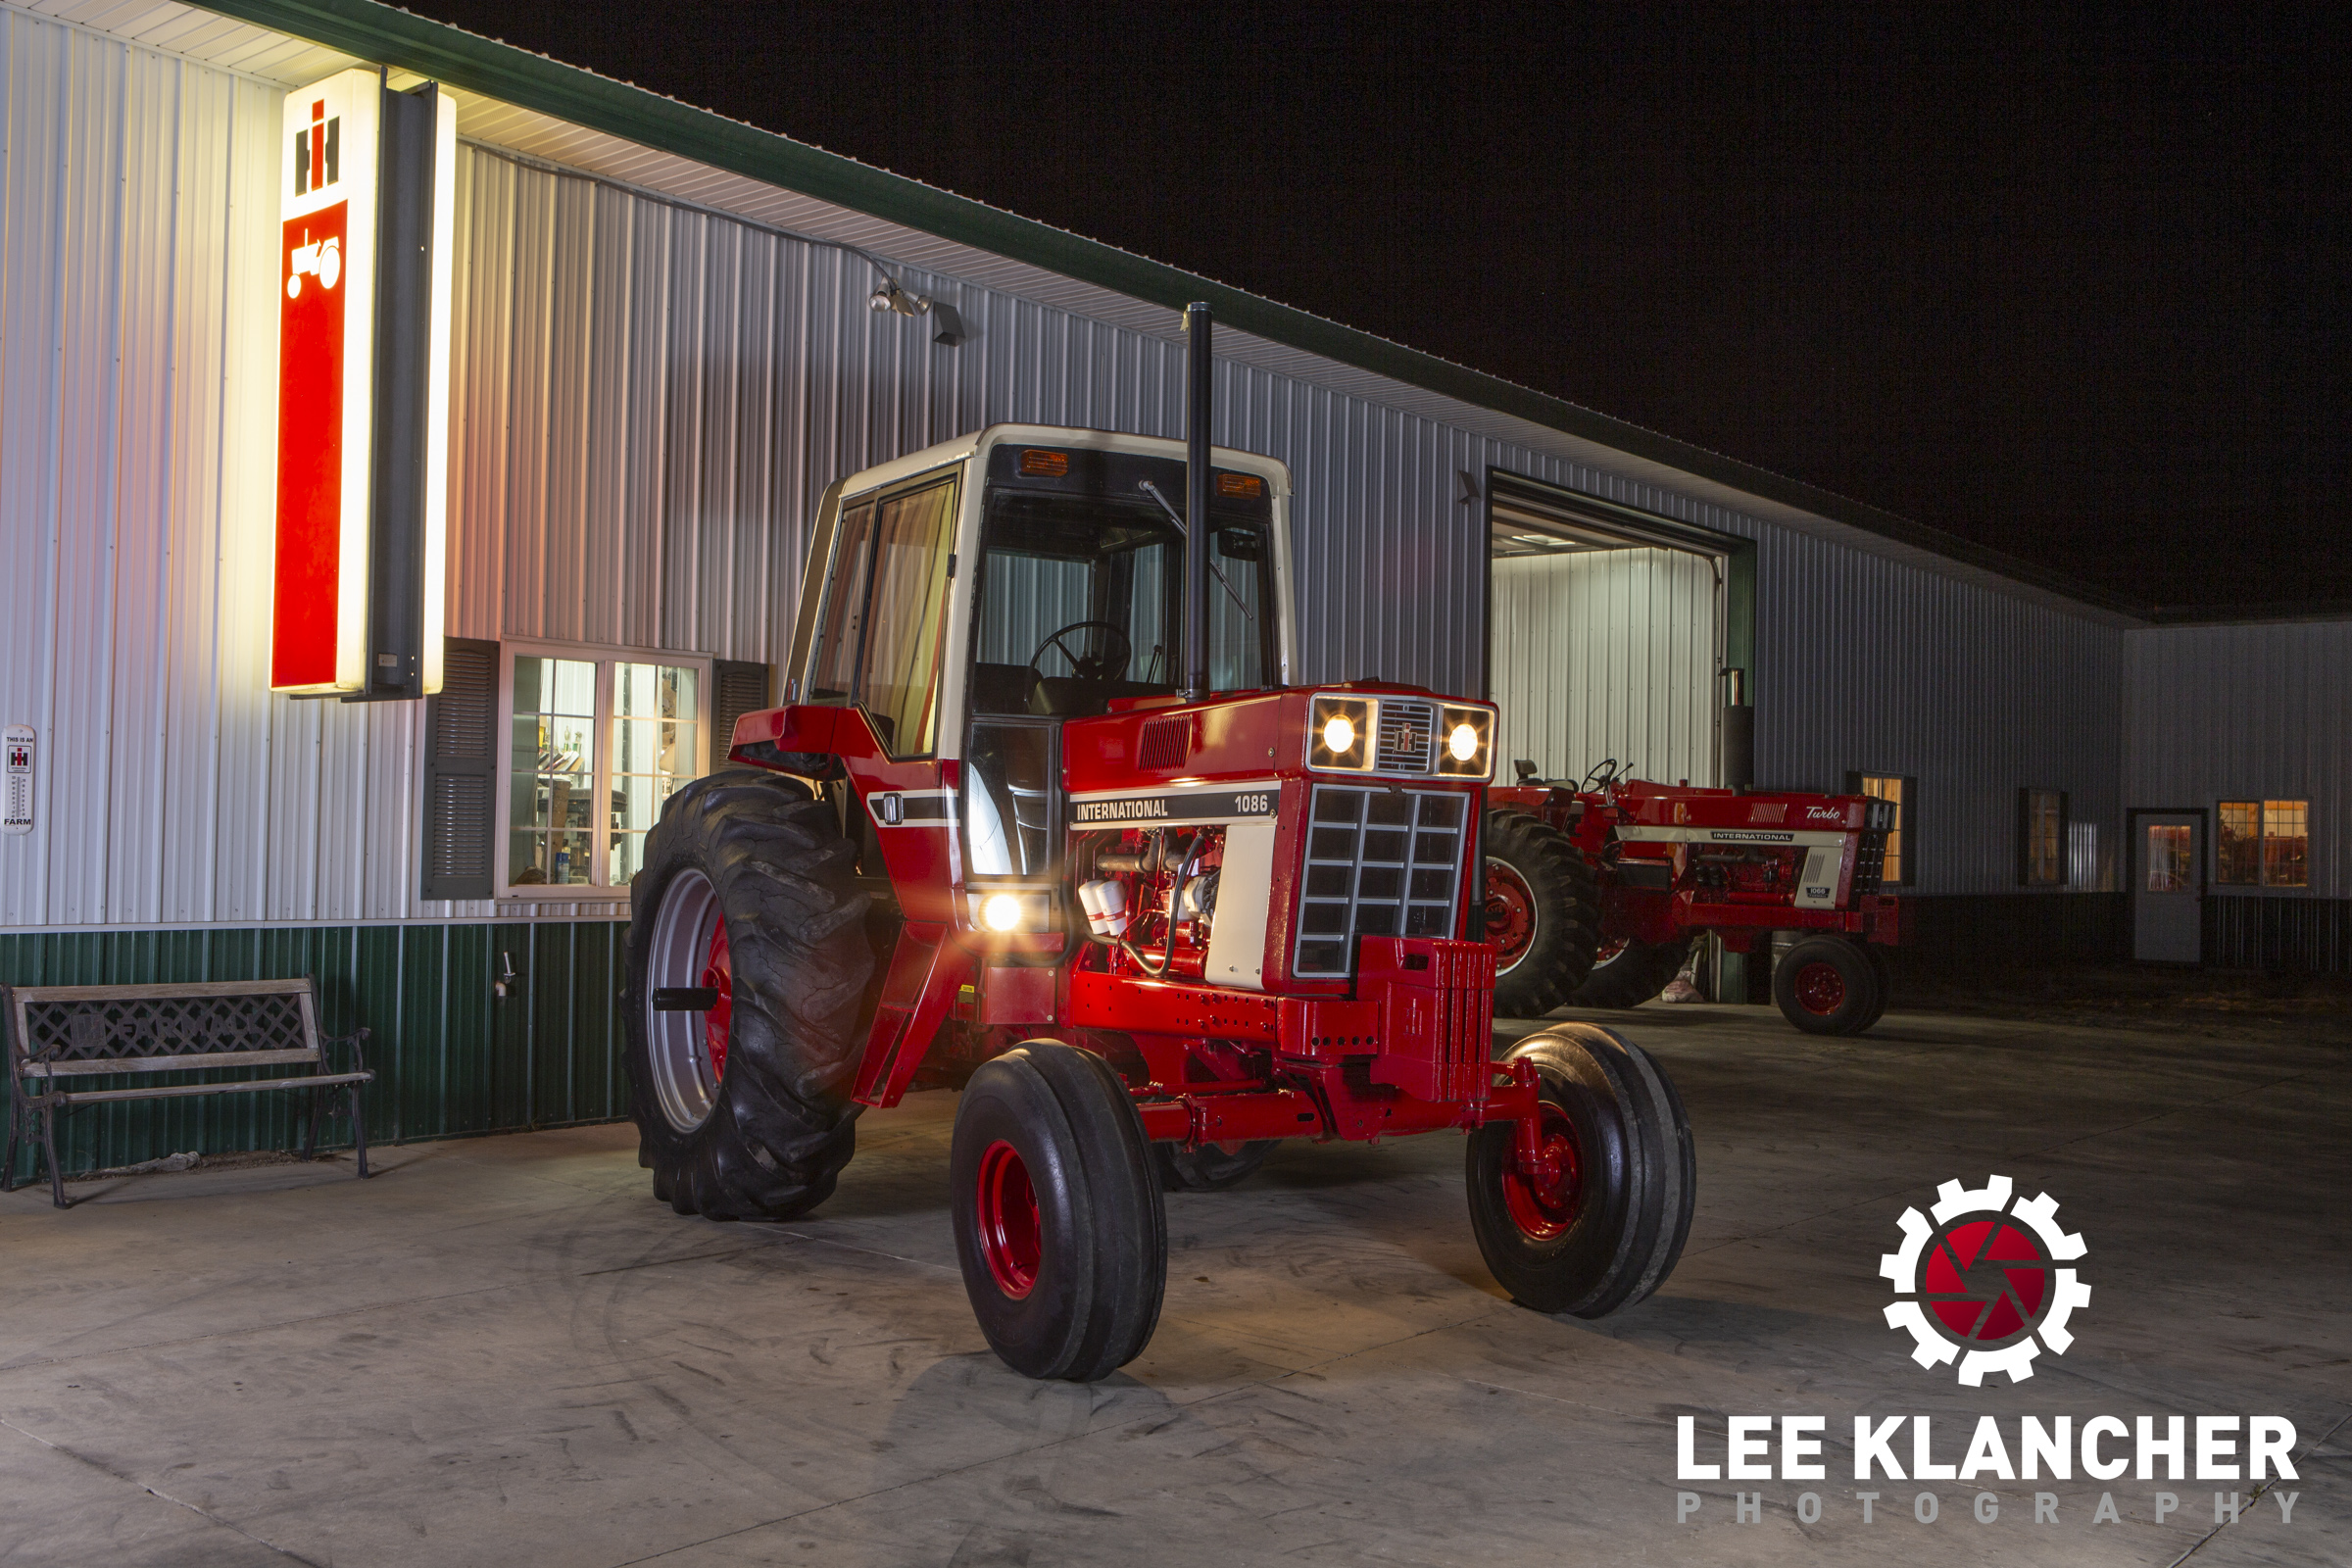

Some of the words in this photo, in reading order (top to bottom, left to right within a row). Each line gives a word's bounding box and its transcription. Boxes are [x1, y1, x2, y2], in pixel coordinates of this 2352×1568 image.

[1077, 799, 1168, 821] INTERNATIONAL
[1235, 794, 1268, 813] 1086
[1806, 806, 1840, 819] Turbo
[1713, 832, 1791, 841] INTERNATIONAL
[117, 1013, 265, 1041] FARMALL
